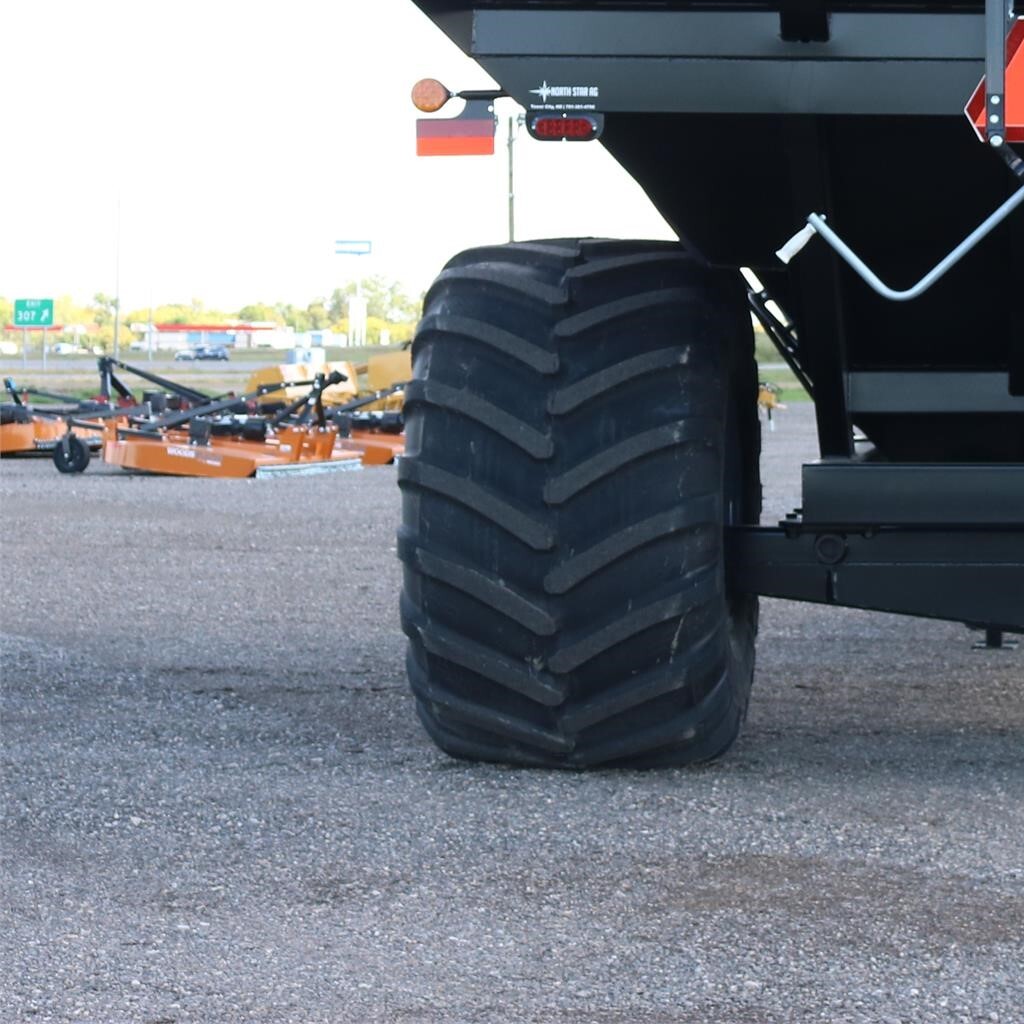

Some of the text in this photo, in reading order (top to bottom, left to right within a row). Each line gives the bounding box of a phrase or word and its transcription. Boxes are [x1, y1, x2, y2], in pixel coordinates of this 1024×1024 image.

[550, 86, 599, 97] NORTH STAR AG
[17, 310, 36, 322] 307
